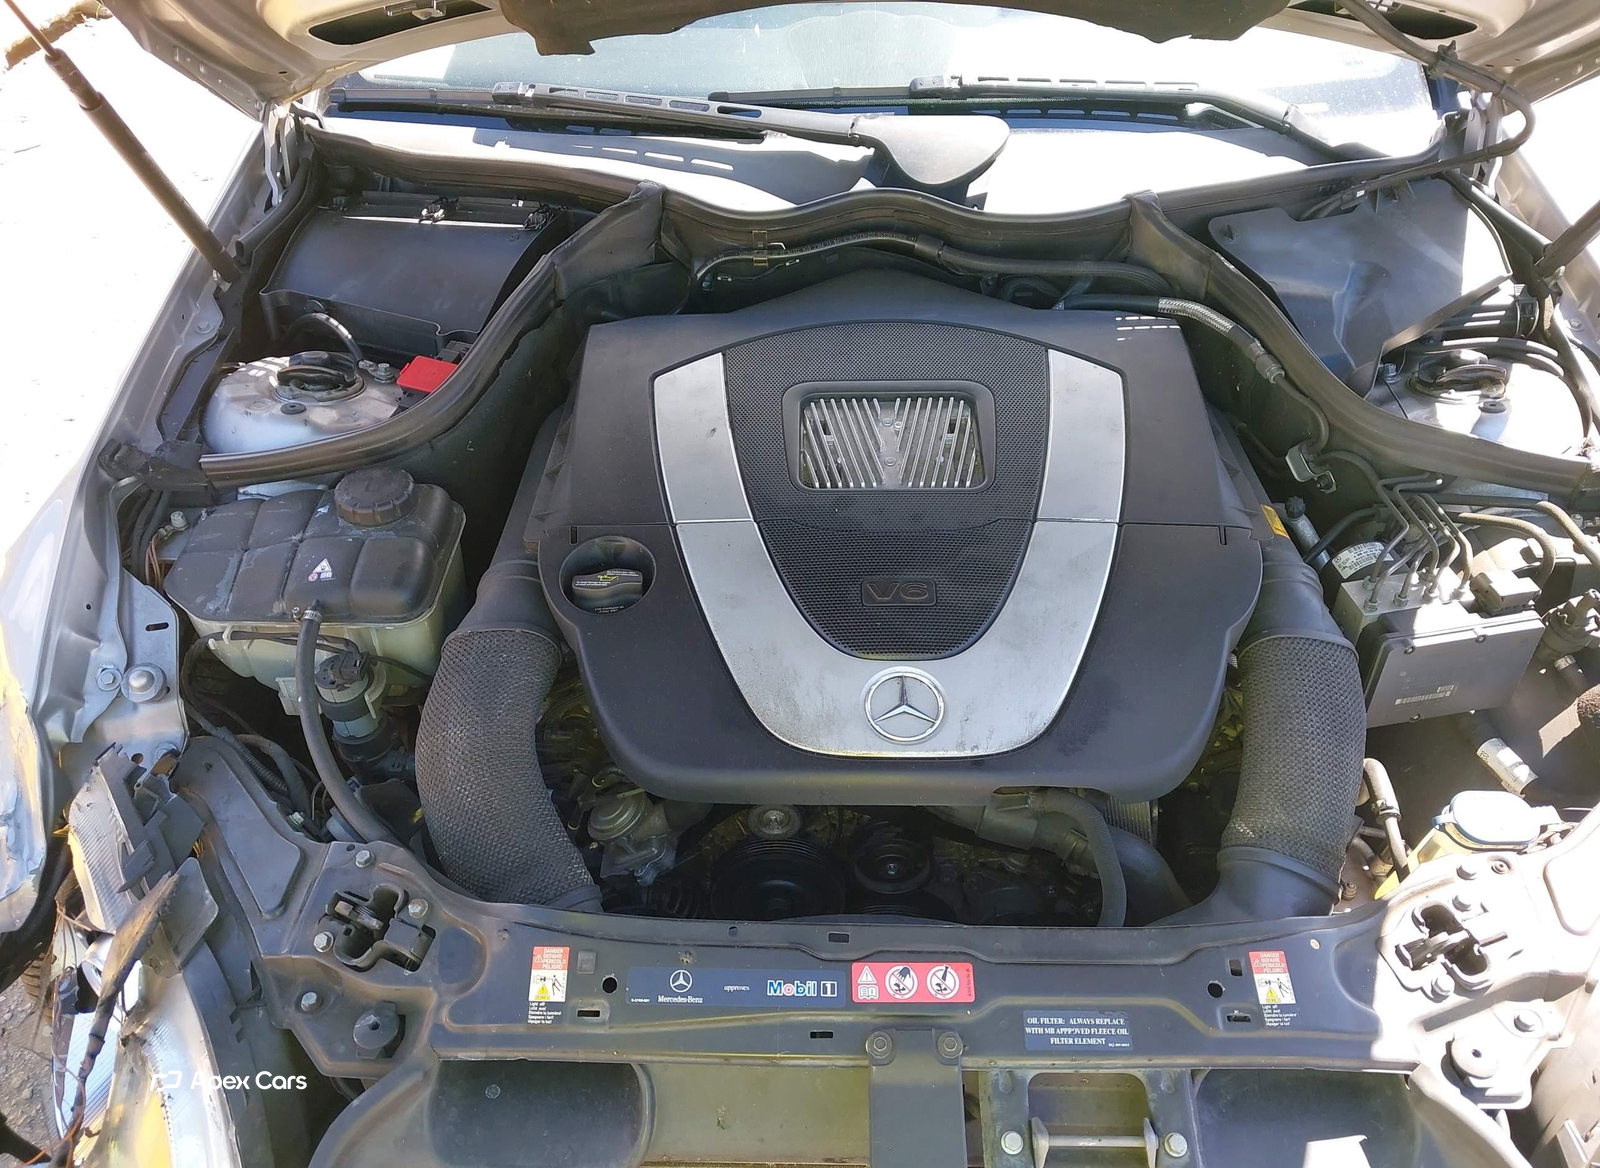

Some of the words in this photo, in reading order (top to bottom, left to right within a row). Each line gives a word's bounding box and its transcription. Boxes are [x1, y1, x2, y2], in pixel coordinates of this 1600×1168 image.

[866, 582, 929, 600] V6
[766, 980, 817, 996] Mobil
[658, 995, 704, 1004] Mercedes-Benz
